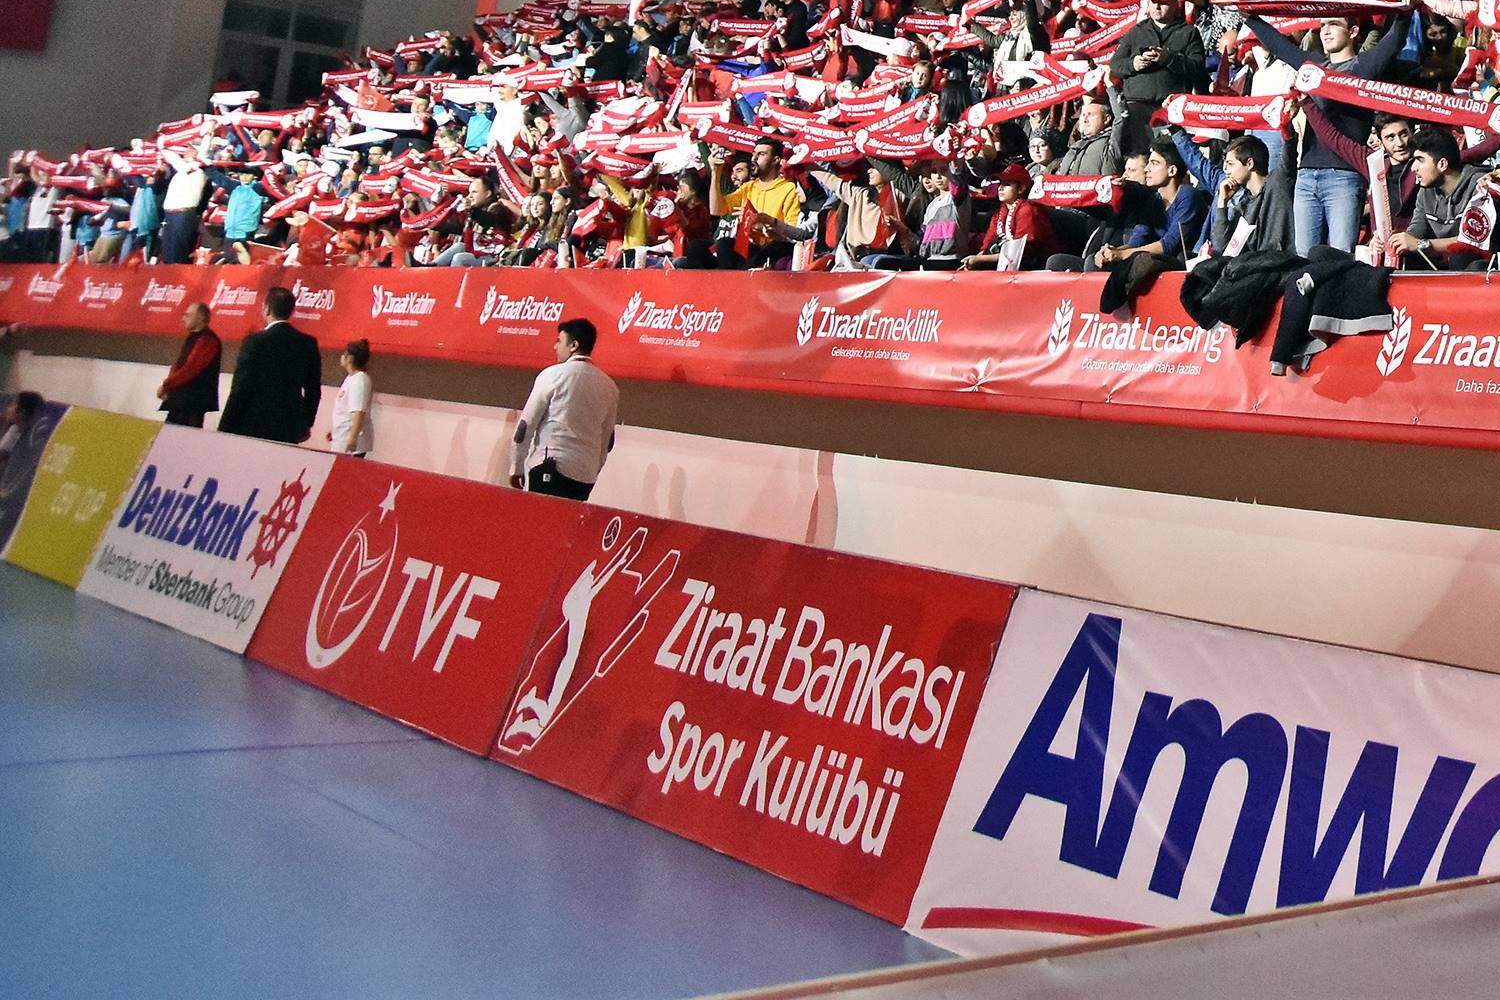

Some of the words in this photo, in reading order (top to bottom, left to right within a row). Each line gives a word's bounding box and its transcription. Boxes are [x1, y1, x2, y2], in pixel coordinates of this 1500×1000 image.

[492, 295, 526, 319] Ziraat
[521, 296, 564, 321] Bankası
[633, 301, 678, 329] Ziraat
[674, 303, 724, 336] Sigorta
[816, 305, 868, 341] Ziraat
[865, 308, 944, 344] Emeklilik
[1076, 313, 1142, 349] Ziraat
[1154, 361, 1175, 374] daha
[1455, 379, 1484, 393] Daha
[118, 464, 259, 561] DenizBank
[148, 560, 218, 610] Sberbank
[213, 582, 255, 630] Group
[379, 556, 502, 674] TVF
[654, 577, 788, 687] Ziraat
[775, 605, 968, 750] Bankası
[647, 701, 747, 795] Spor
[740, 733, 905, 858] Kulübü
